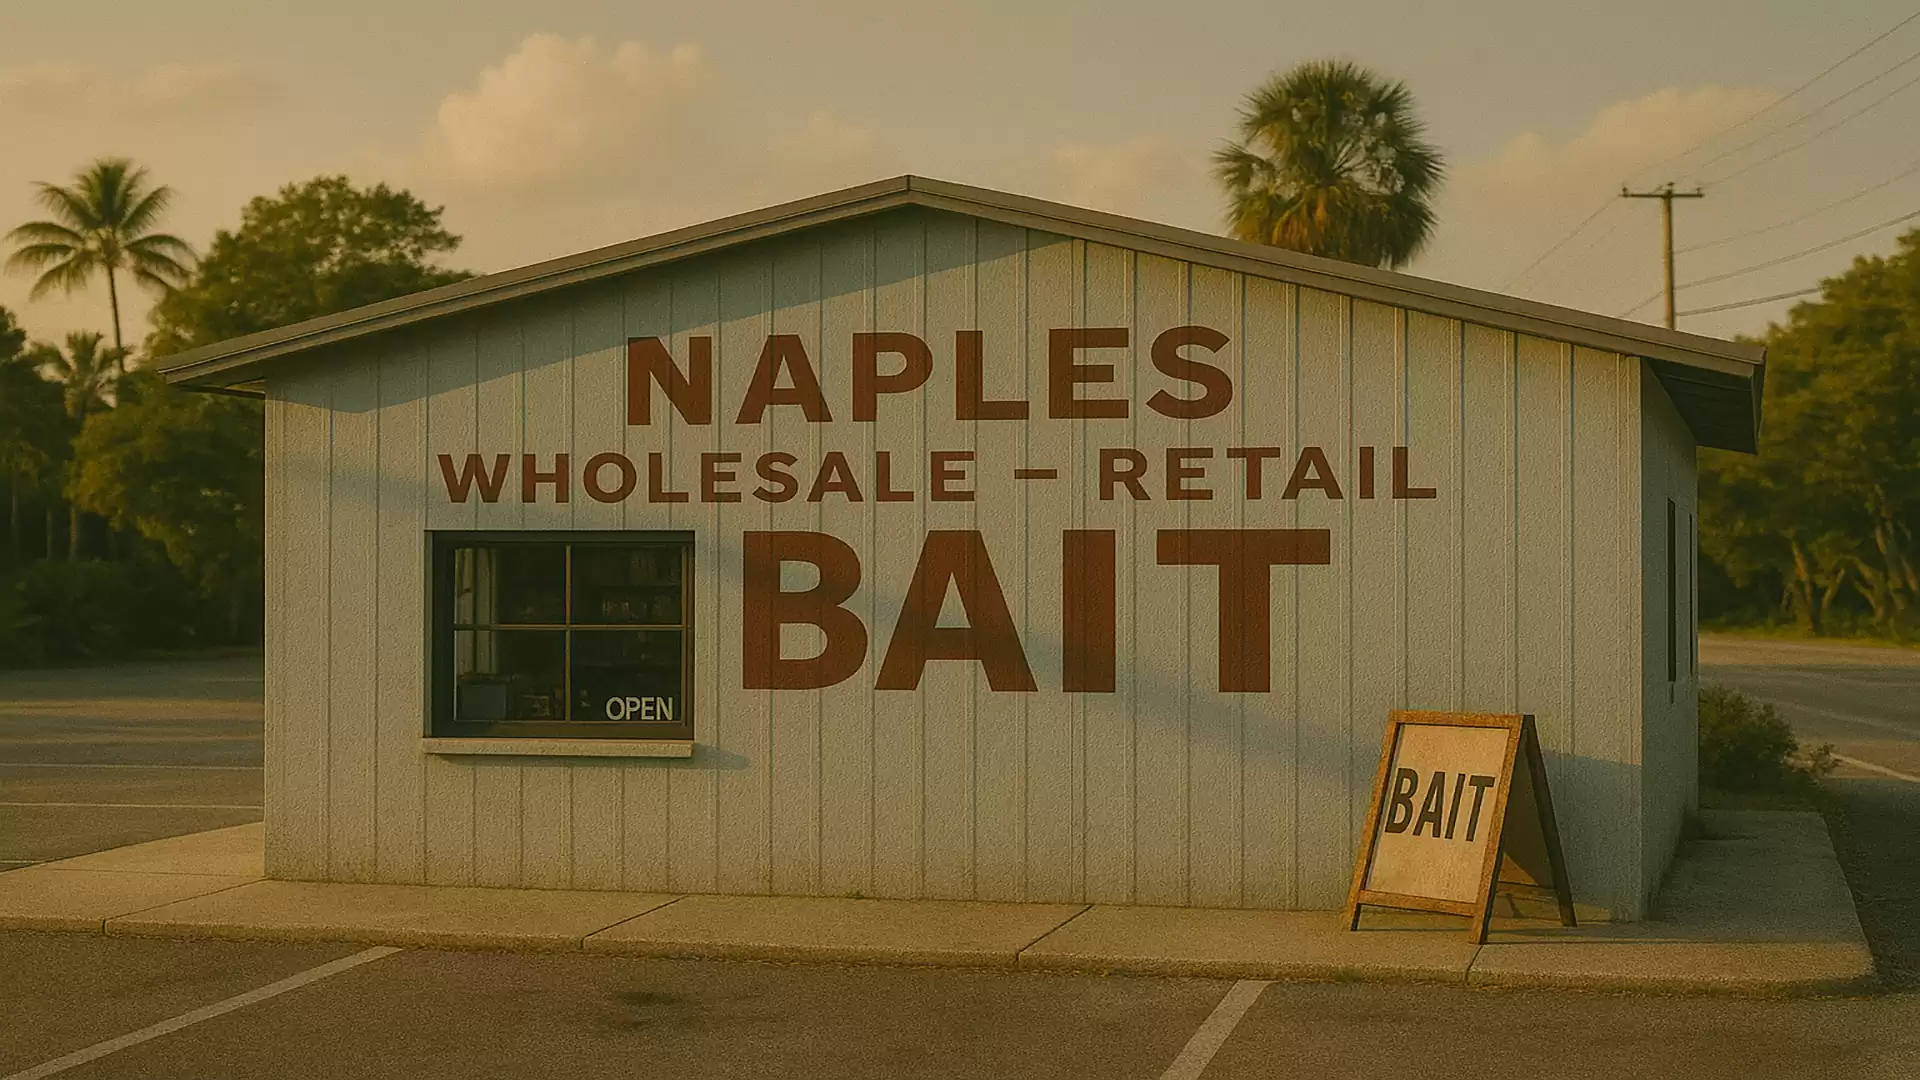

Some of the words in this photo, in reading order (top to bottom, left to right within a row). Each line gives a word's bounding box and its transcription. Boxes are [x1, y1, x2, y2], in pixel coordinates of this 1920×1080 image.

[626, 325, 1233, 426] NAPLES
[437, 450, 975, 504] WHOLESALE
[1099, 446, 1437, 501] RETAIL
[742, 529, 1331, 694] BAIT
[605, 696, 673, 721] OPEN
[1384, 767, 1496, 842] BAIT
